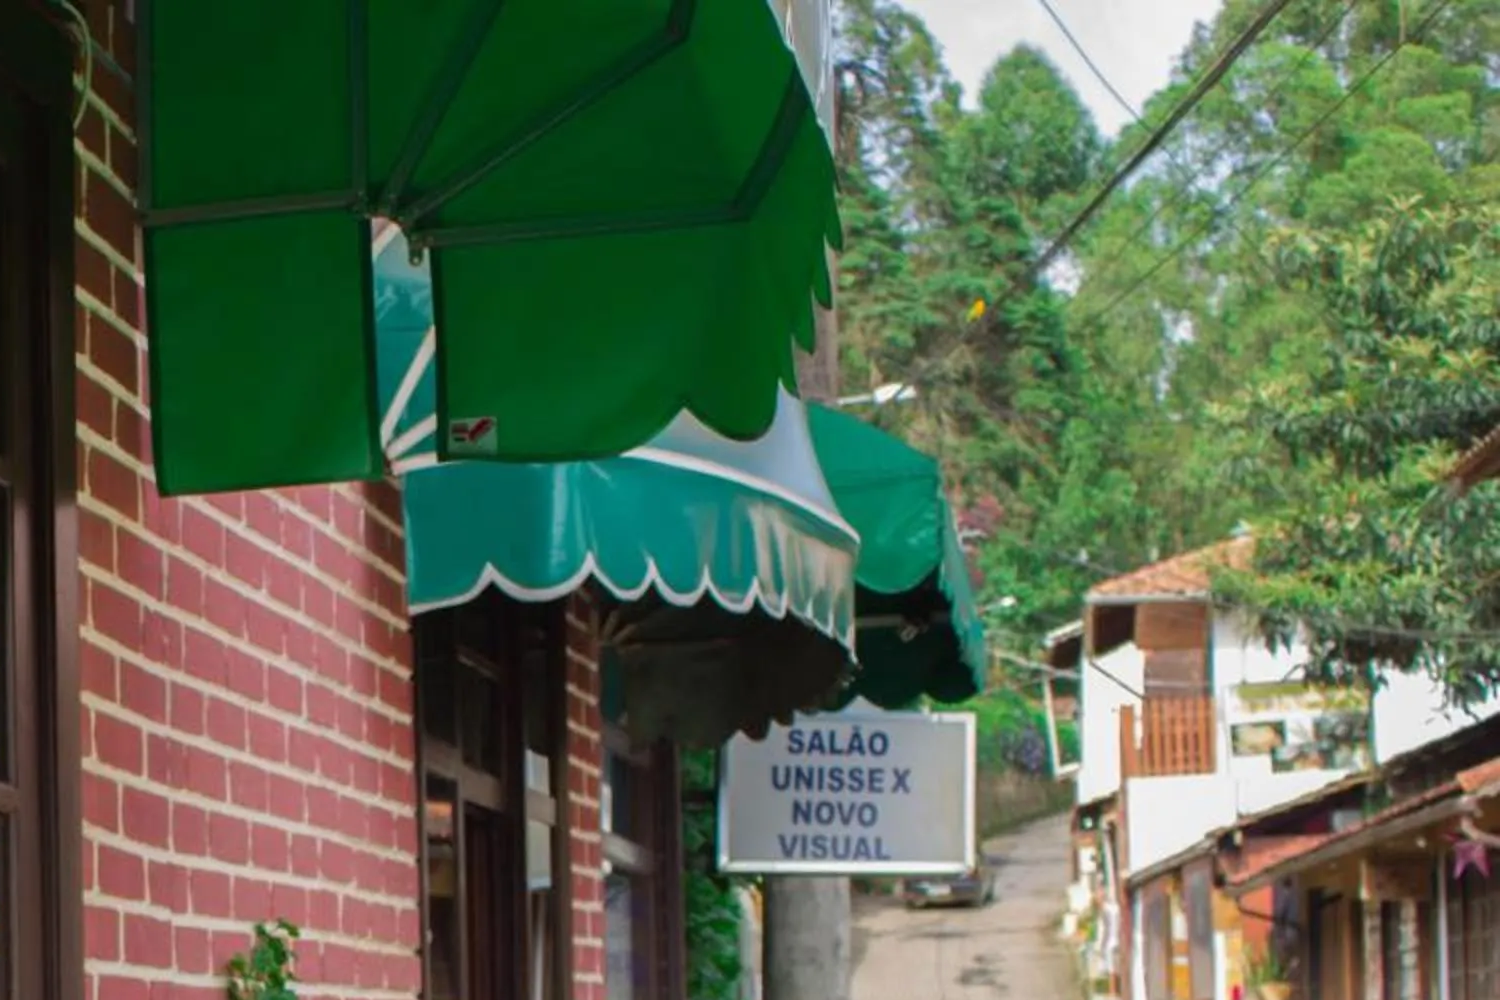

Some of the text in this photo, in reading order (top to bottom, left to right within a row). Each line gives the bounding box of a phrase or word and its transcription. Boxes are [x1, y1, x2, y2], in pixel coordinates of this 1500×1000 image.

[787, 725, 889, 756] SALÃO
[791, 800, 879, 828] NOVO
[778, 833, 891, 861] VISUAL
